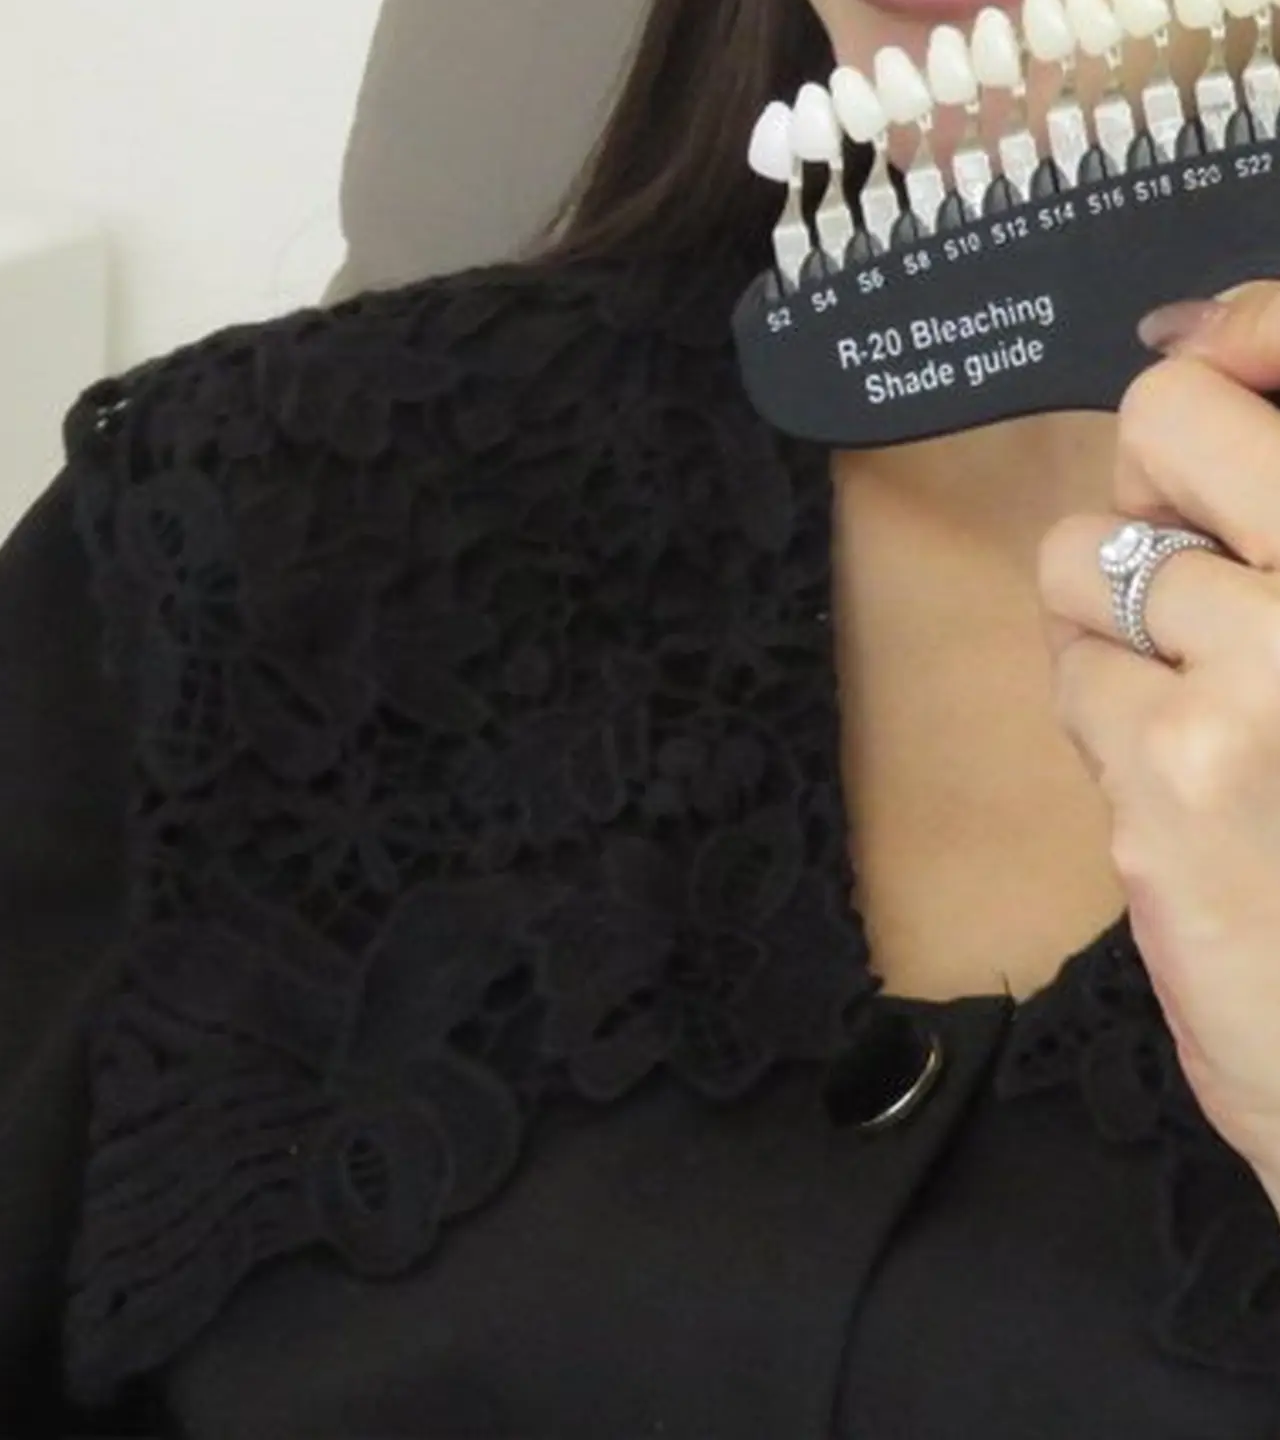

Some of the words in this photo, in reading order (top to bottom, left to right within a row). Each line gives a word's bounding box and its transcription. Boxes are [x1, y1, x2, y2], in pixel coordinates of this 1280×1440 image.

[767, 308, 792, 332] S2
[811, 289, 839, 312] S4
[858, 269, 884, 294] S6
[904, 251, 931, 276] S8
[944, 232, 981, 260] S10
[993, 217, 1029, 244] S12
[1039, 202, 1076, 229] S14
[1088, 188, 1124, 215] S16
[1135, 174, 1172, 202] S18
[1184, 164, 1221, 191] S20
[1235, 154, 1273, 179] S22
[838, 327, 902, 369] R-20
[911, 294, 1056, 351] Bleaching
[865, 358, 955, 404] Shade
[967, 336, 1045, 385] guide
